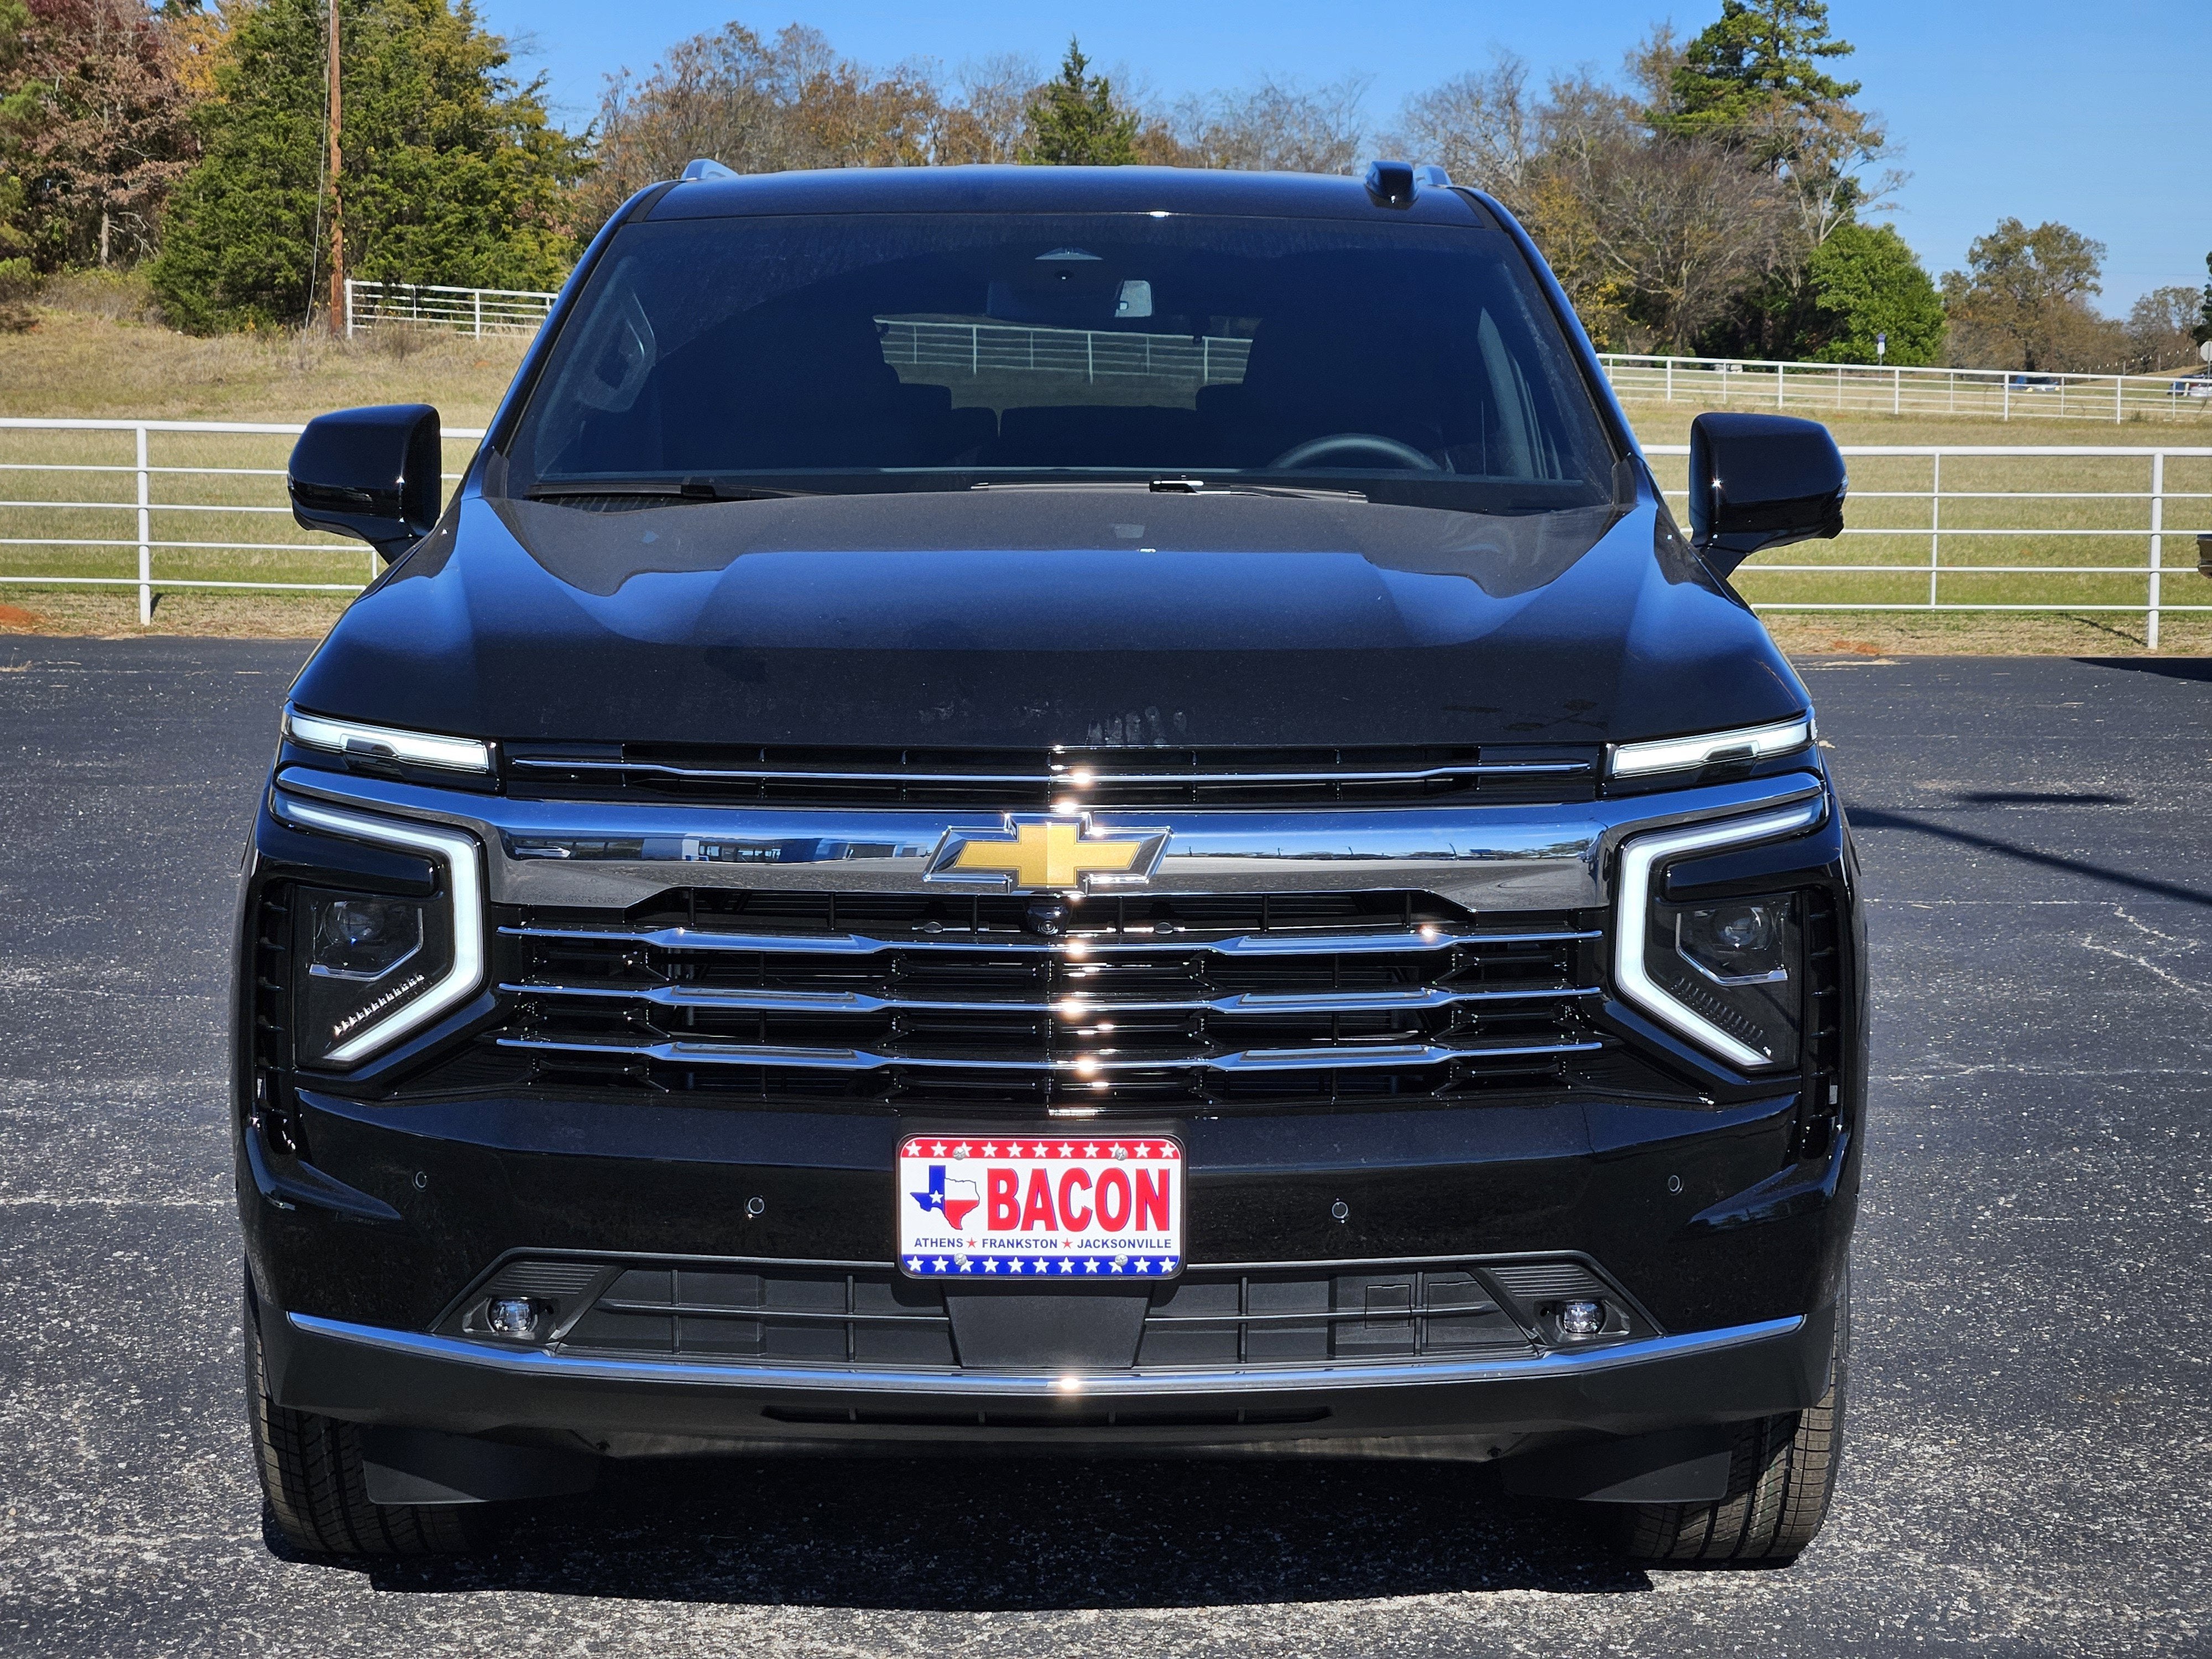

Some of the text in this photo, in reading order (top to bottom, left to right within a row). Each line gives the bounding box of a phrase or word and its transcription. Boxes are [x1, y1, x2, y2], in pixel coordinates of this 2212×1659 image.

[987, 1167, 1170, 1232] BACON
[914, 1238, 1171, 1249] ATHENS FRANKSTON JACKSONVILLE
